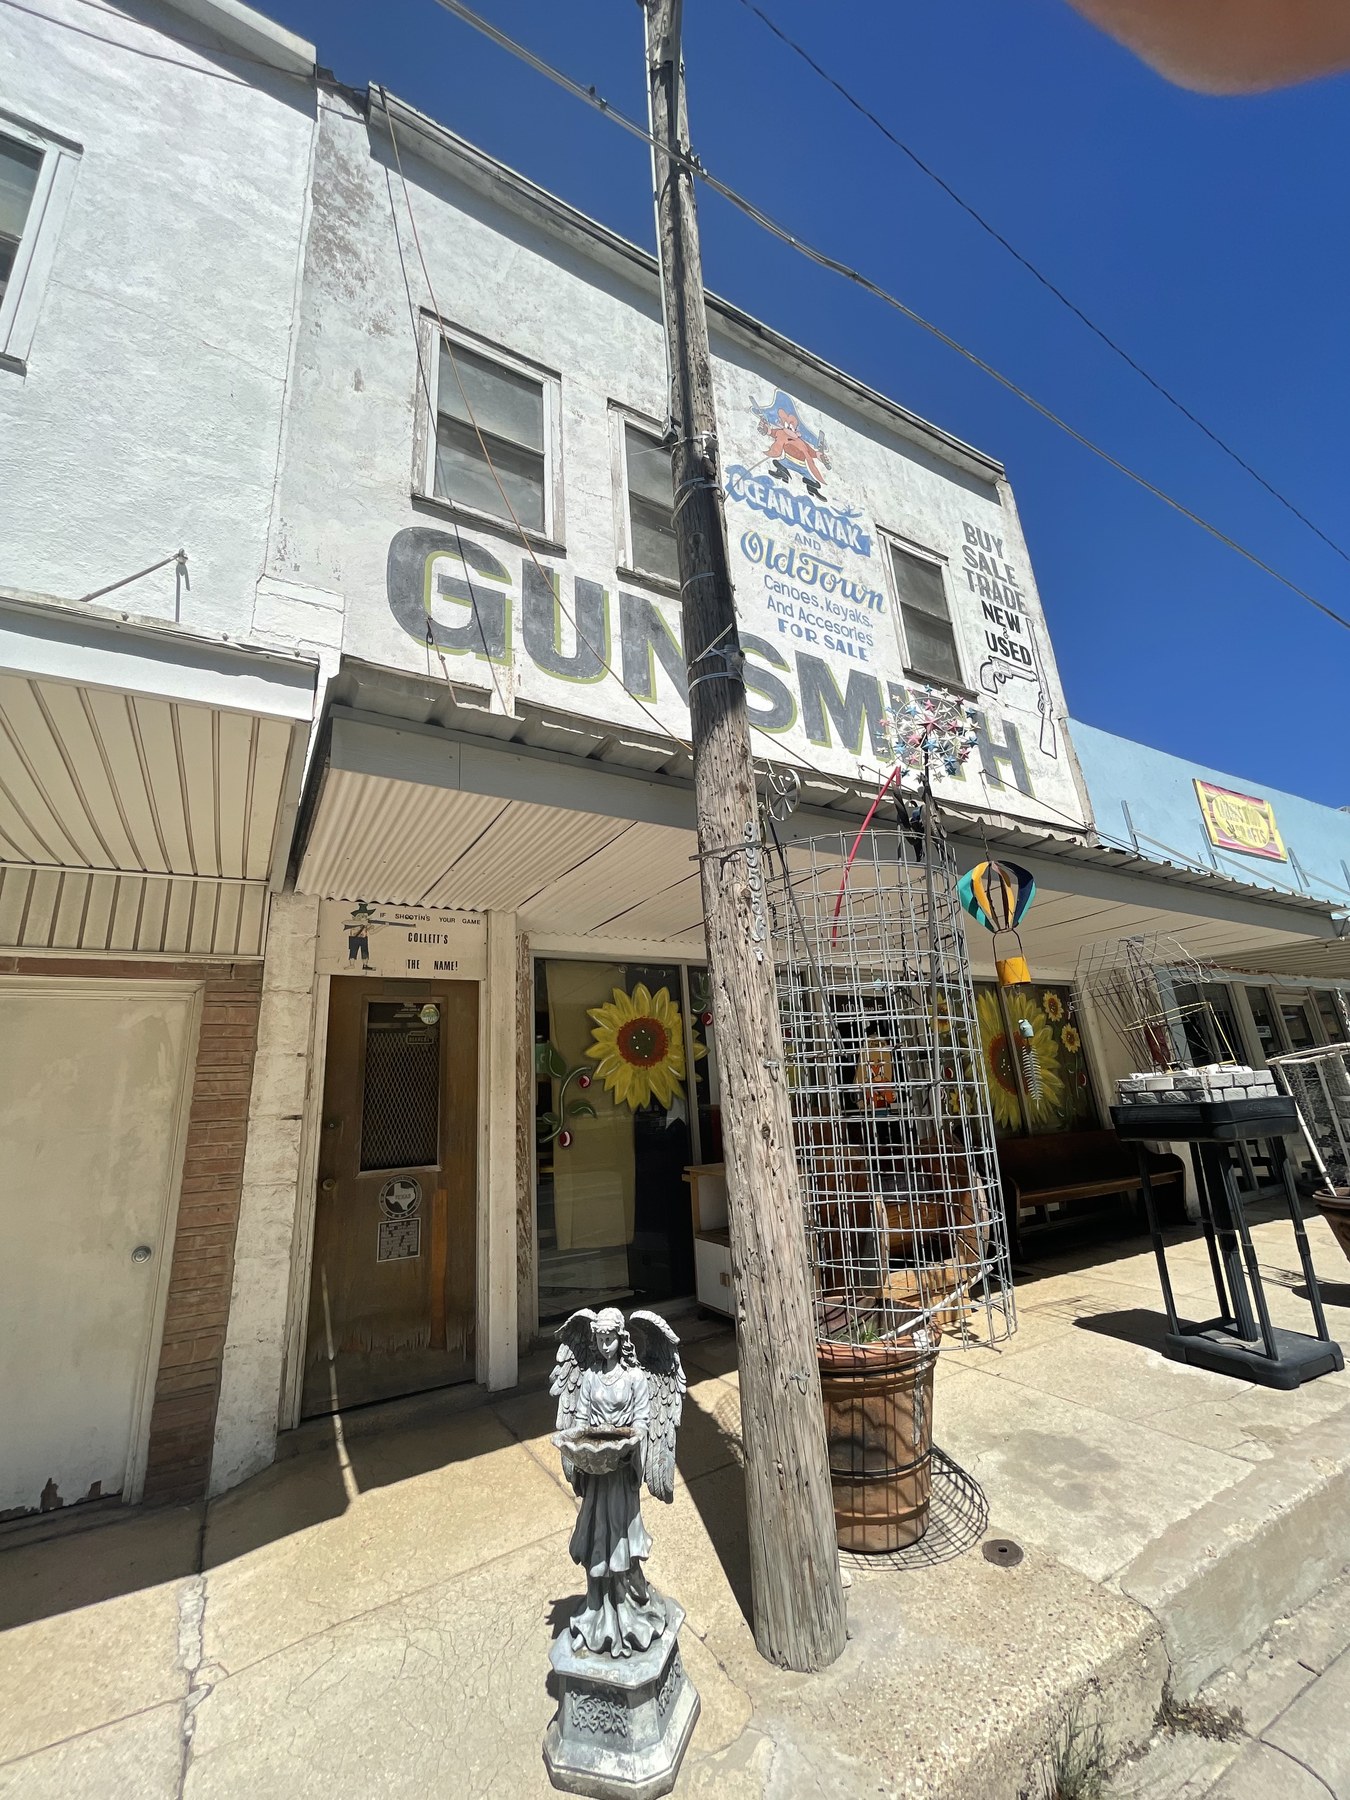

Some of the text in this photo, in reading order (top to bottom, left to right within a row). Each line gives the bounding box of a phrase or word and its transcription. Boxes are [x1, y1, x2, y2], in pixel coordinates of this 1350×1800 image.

[732, 471, 864, 549] OCEAN KAYAK
[794, 532, 822, 552] AND
[961, 520, 1004, 560] BUY
[961, 544, 1020, 590] SALE
[961, 565, 1030, 616] TRADE
[767, 594, 874, 648] And Accesories
[980, 599, 1022, 634] NEW
[1002, 627, 1010, 640] &
[777, 617, 870, 663] FOR SALE
[984, 629, 1033, 667] USED
[407, 932, 449, 945] COLLETT'S
[438, 916, 456, 924] YOUR
[461, 918, 481, 926] GAME
[407, 959, 459, 971] THE NAME!
